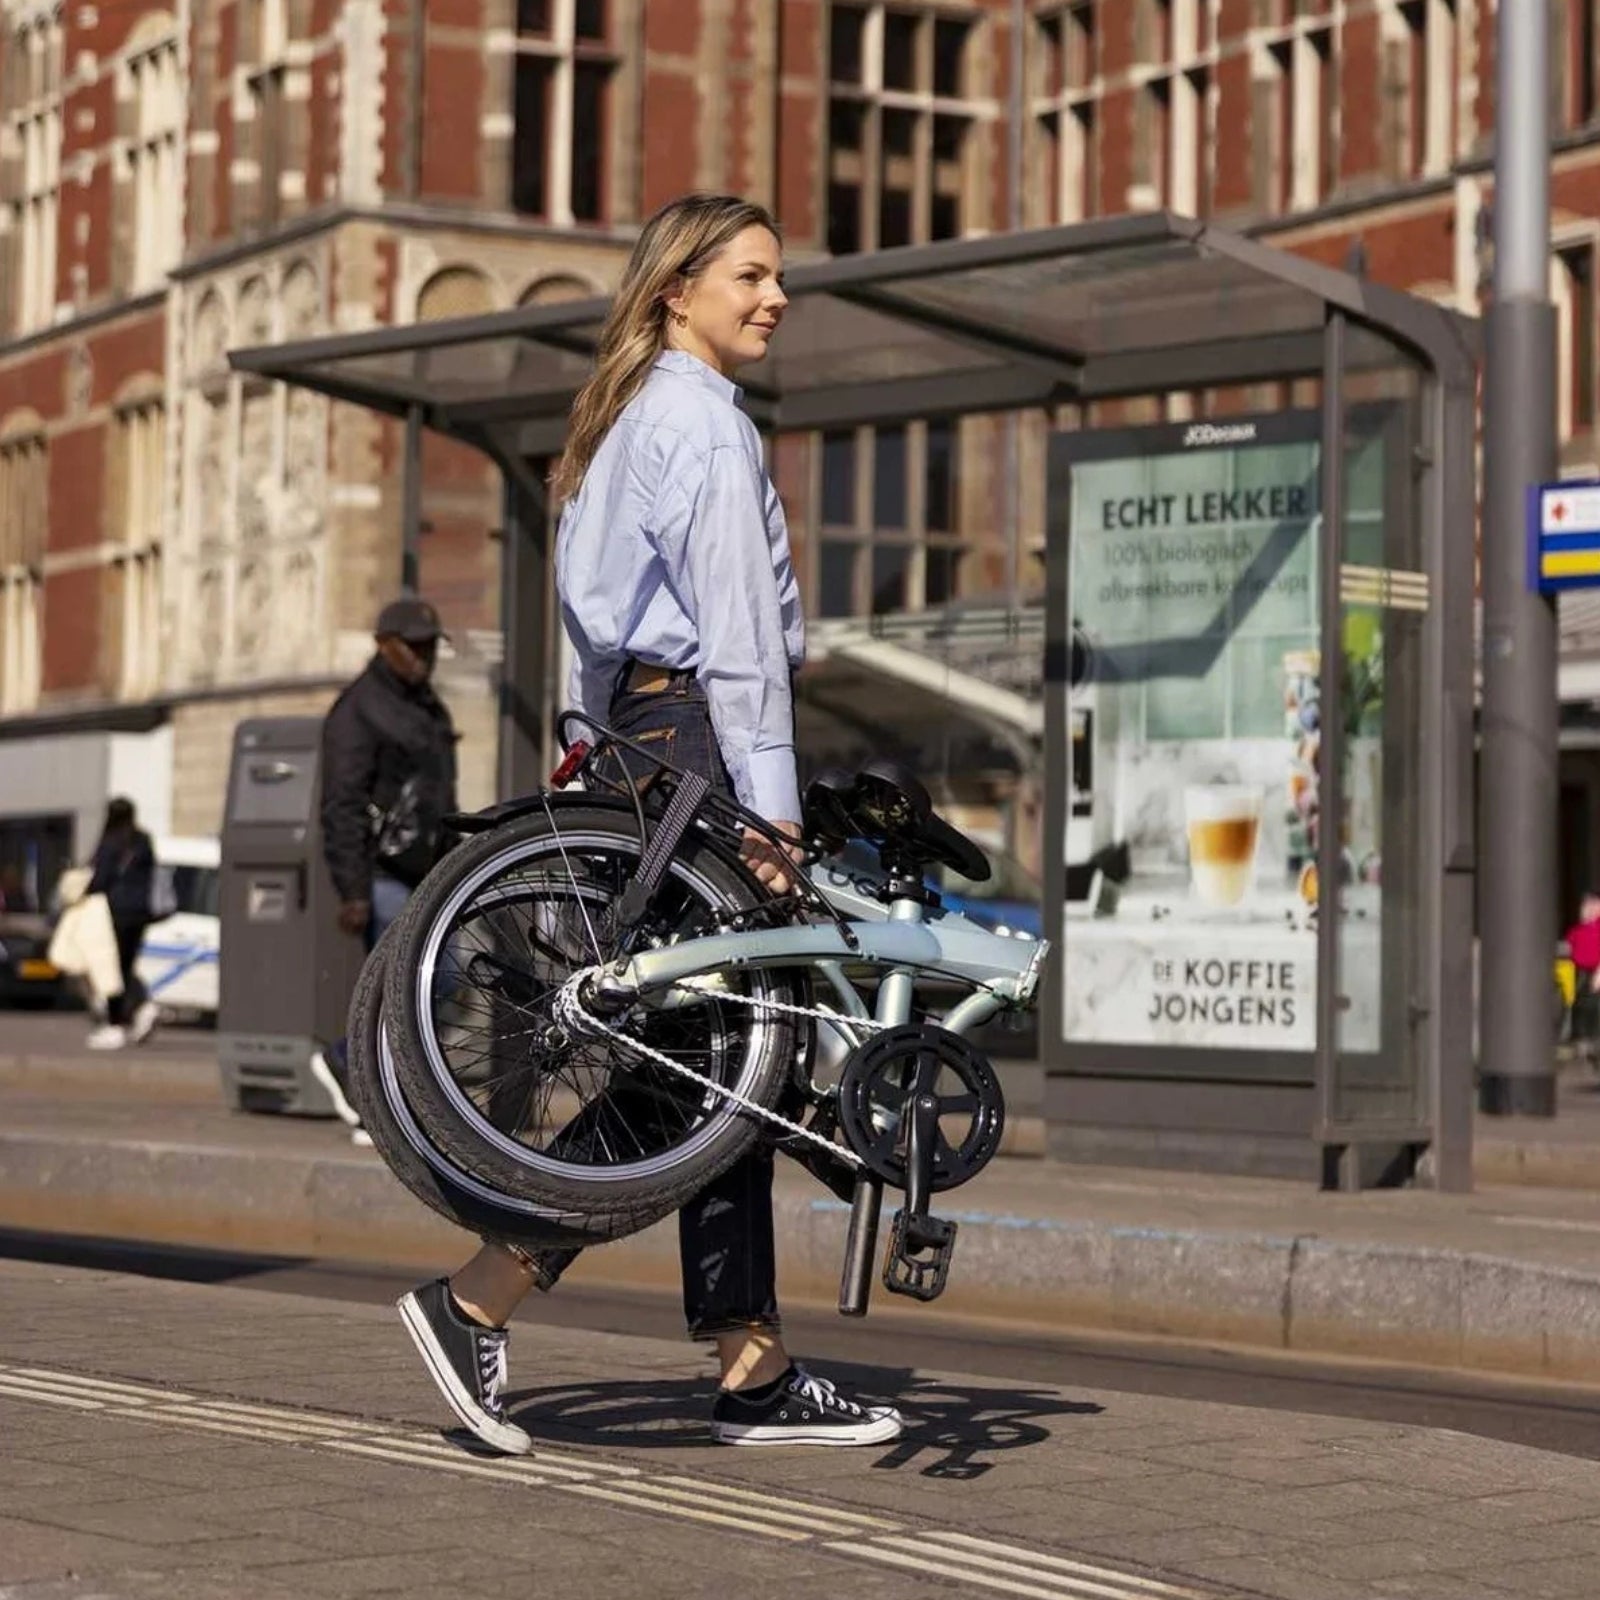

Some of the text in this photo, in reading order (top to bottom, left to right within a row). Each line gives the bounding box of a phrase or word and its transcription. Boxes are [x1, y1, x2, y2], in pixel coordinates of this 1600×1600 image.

[1102, 486, 1306, 530] ECHT LEKKER
[1104, 543, 1151, 566] 100%
[1153, 958, 1295, 990] DE KOFFIE
[1149, 994, 1295, 1027] JONGENS
